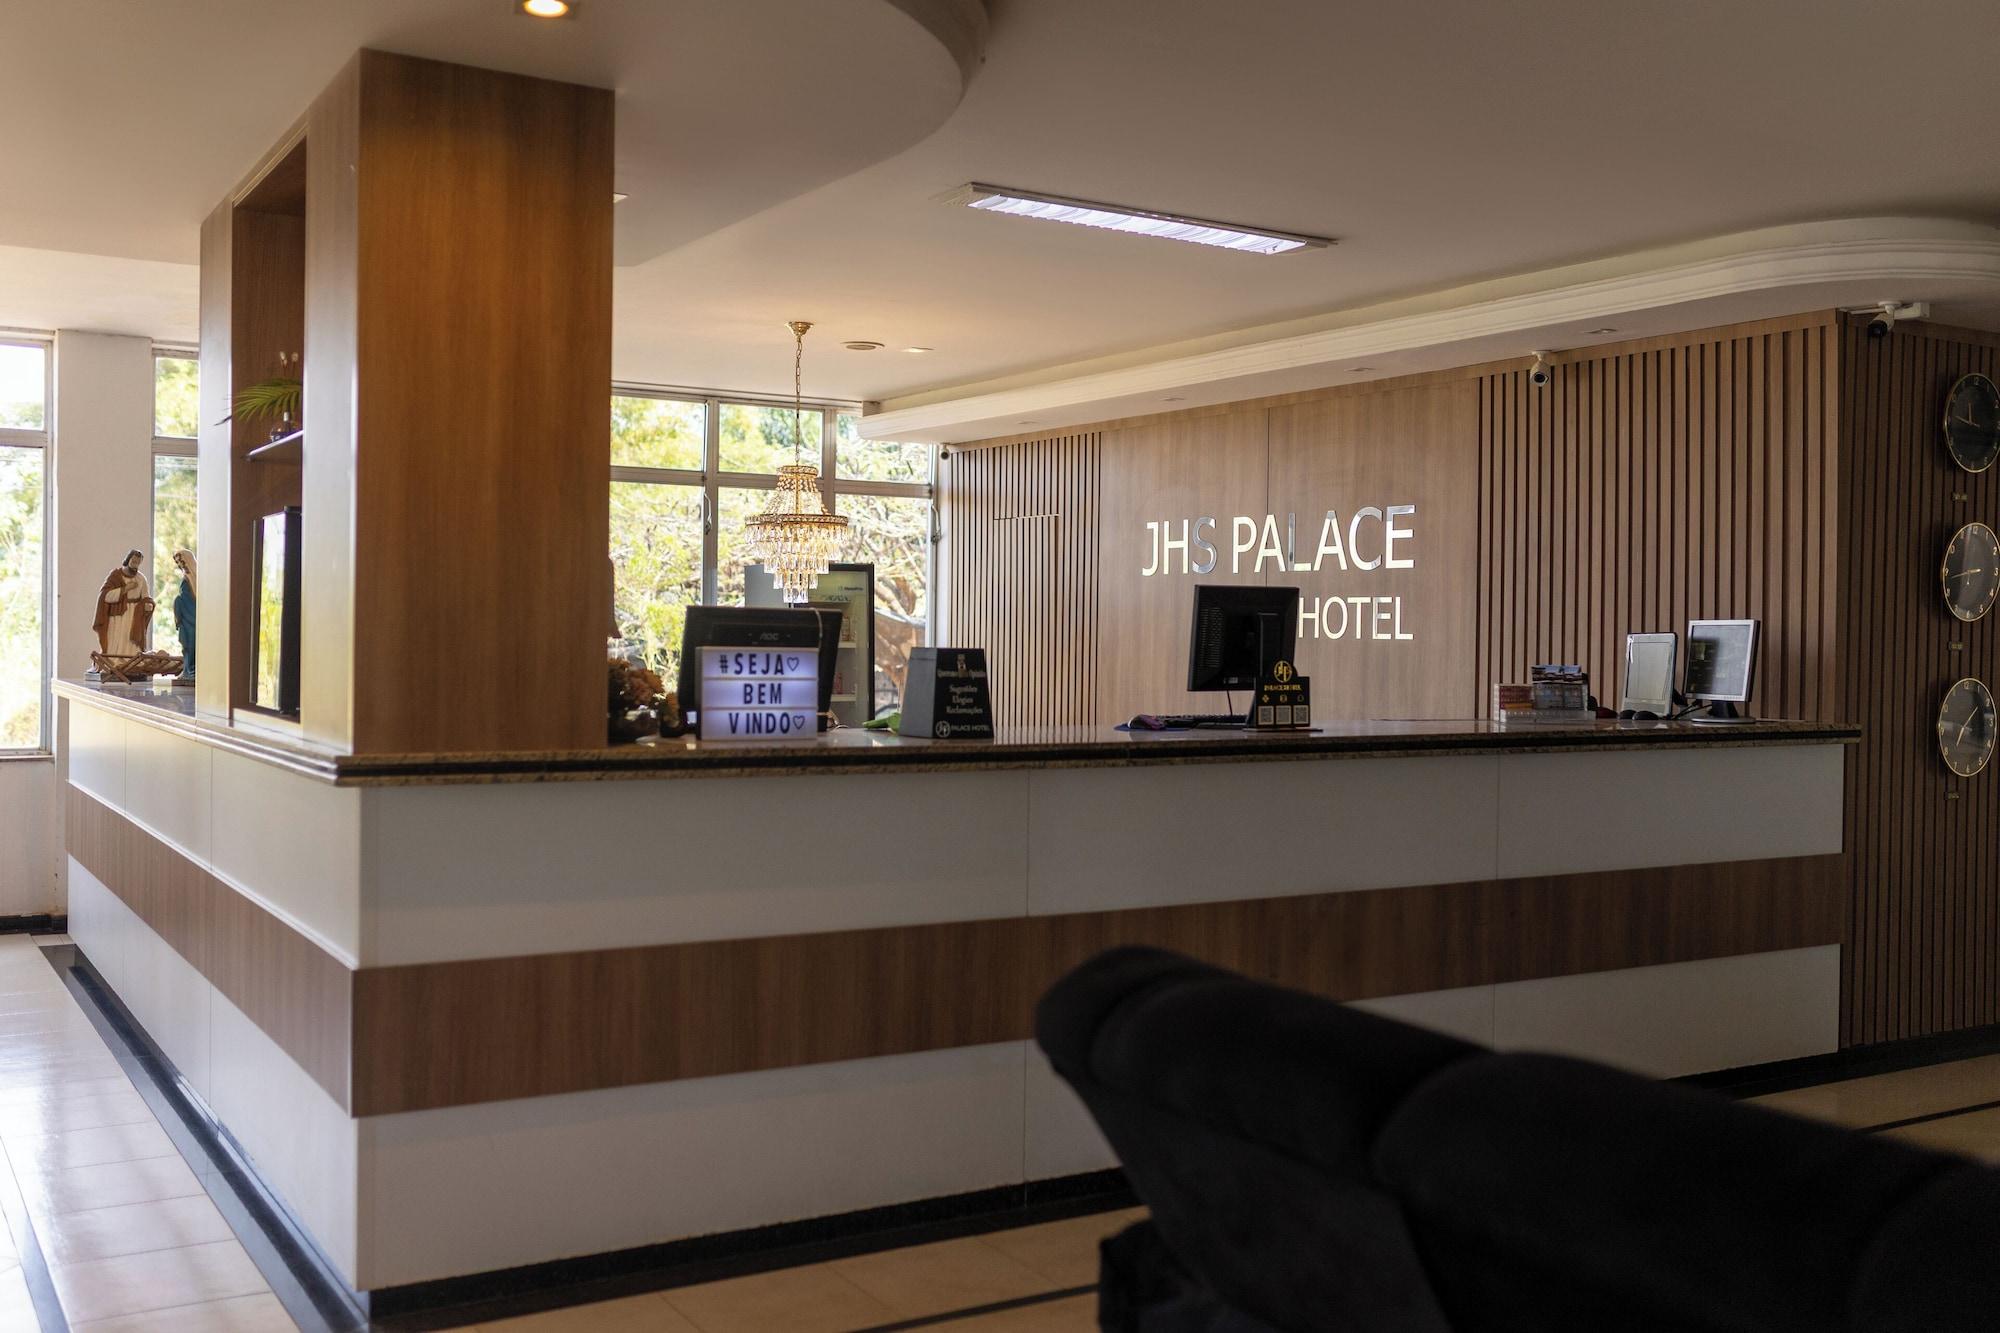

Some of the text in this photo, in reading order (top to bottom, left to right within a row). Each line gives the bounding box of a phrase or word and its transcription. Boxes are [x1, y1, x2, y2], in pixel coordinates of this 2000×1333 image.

[1141, 504, 1416, 576] JHS PALACE
[1298, 596, 1414, 640] HOTEL
[720, 653, 784, 675] #SEJA
[744, 683, 782, 704] BEM
